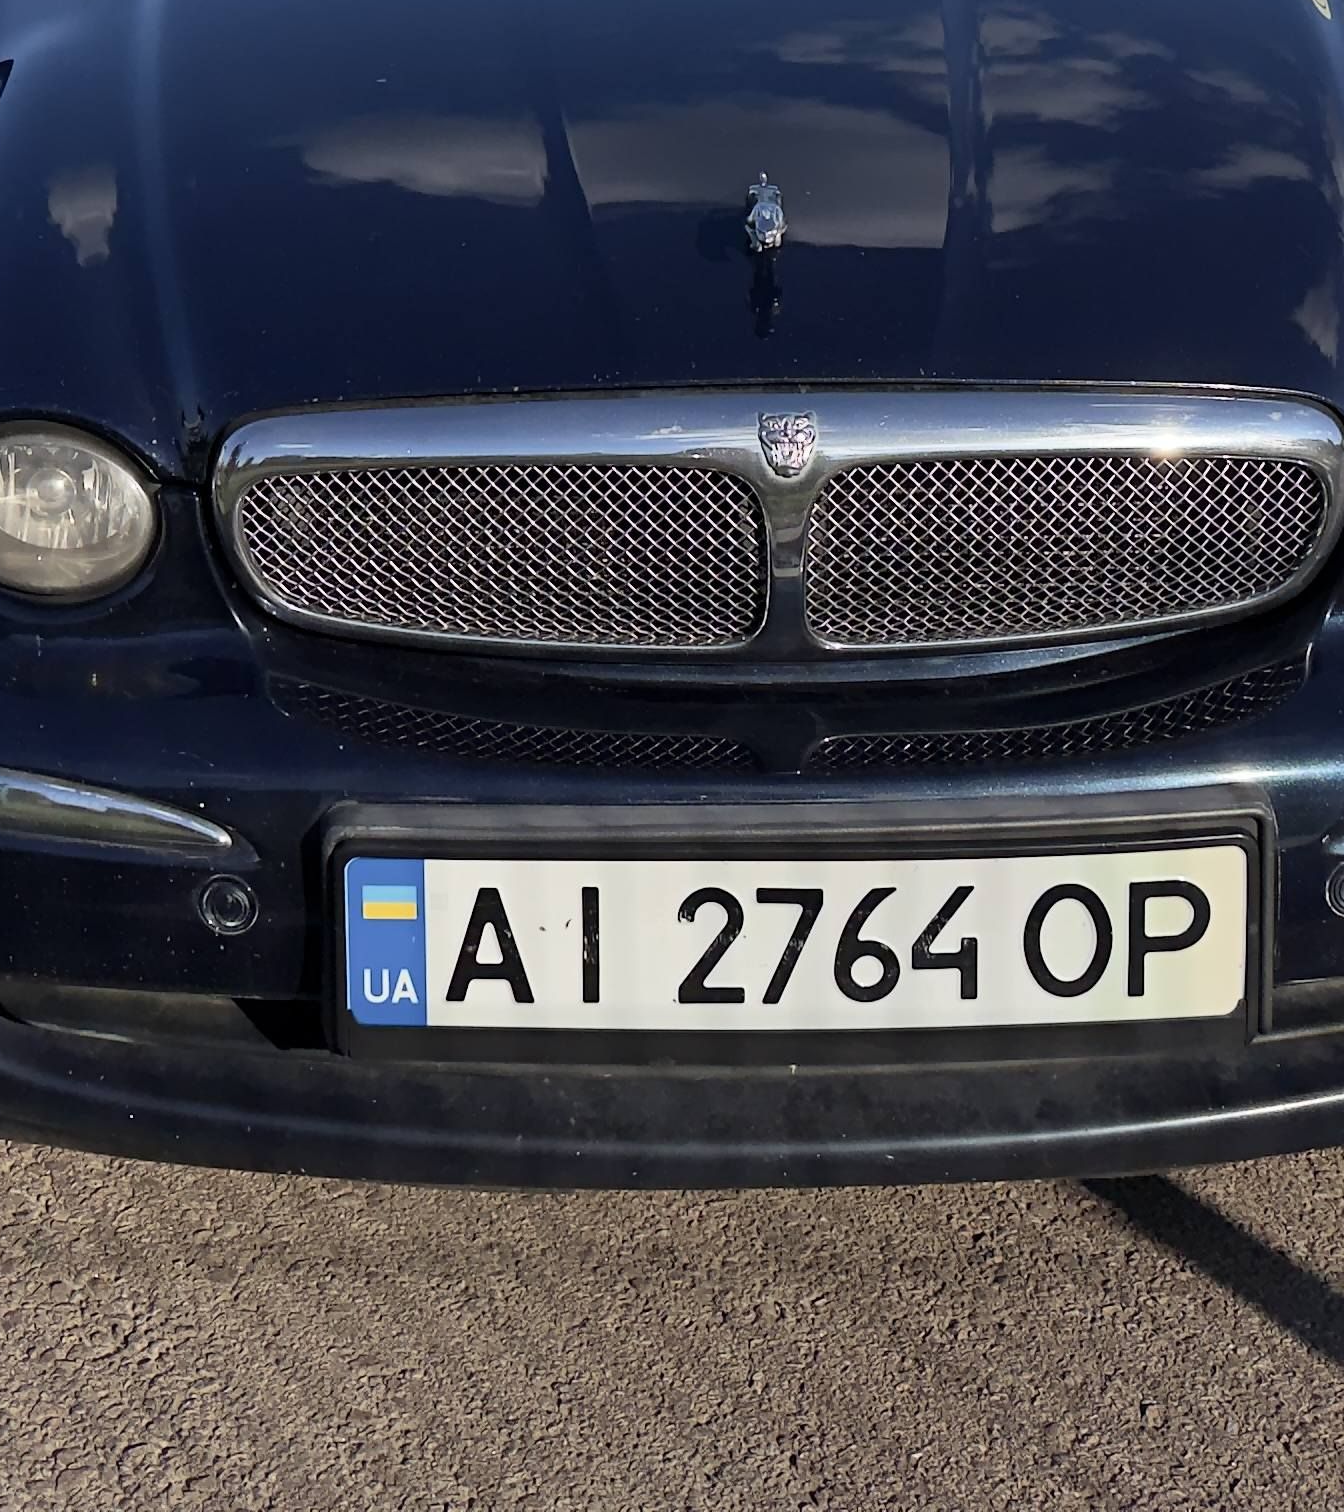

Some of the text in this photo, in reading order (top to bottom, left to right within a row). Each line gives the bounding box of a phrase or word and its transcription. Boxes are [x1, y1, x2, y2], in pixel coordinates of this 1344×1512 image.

[444, 879, 1212, 1005] AI 2764 OP
[363, 969, 418, 1005] UA
